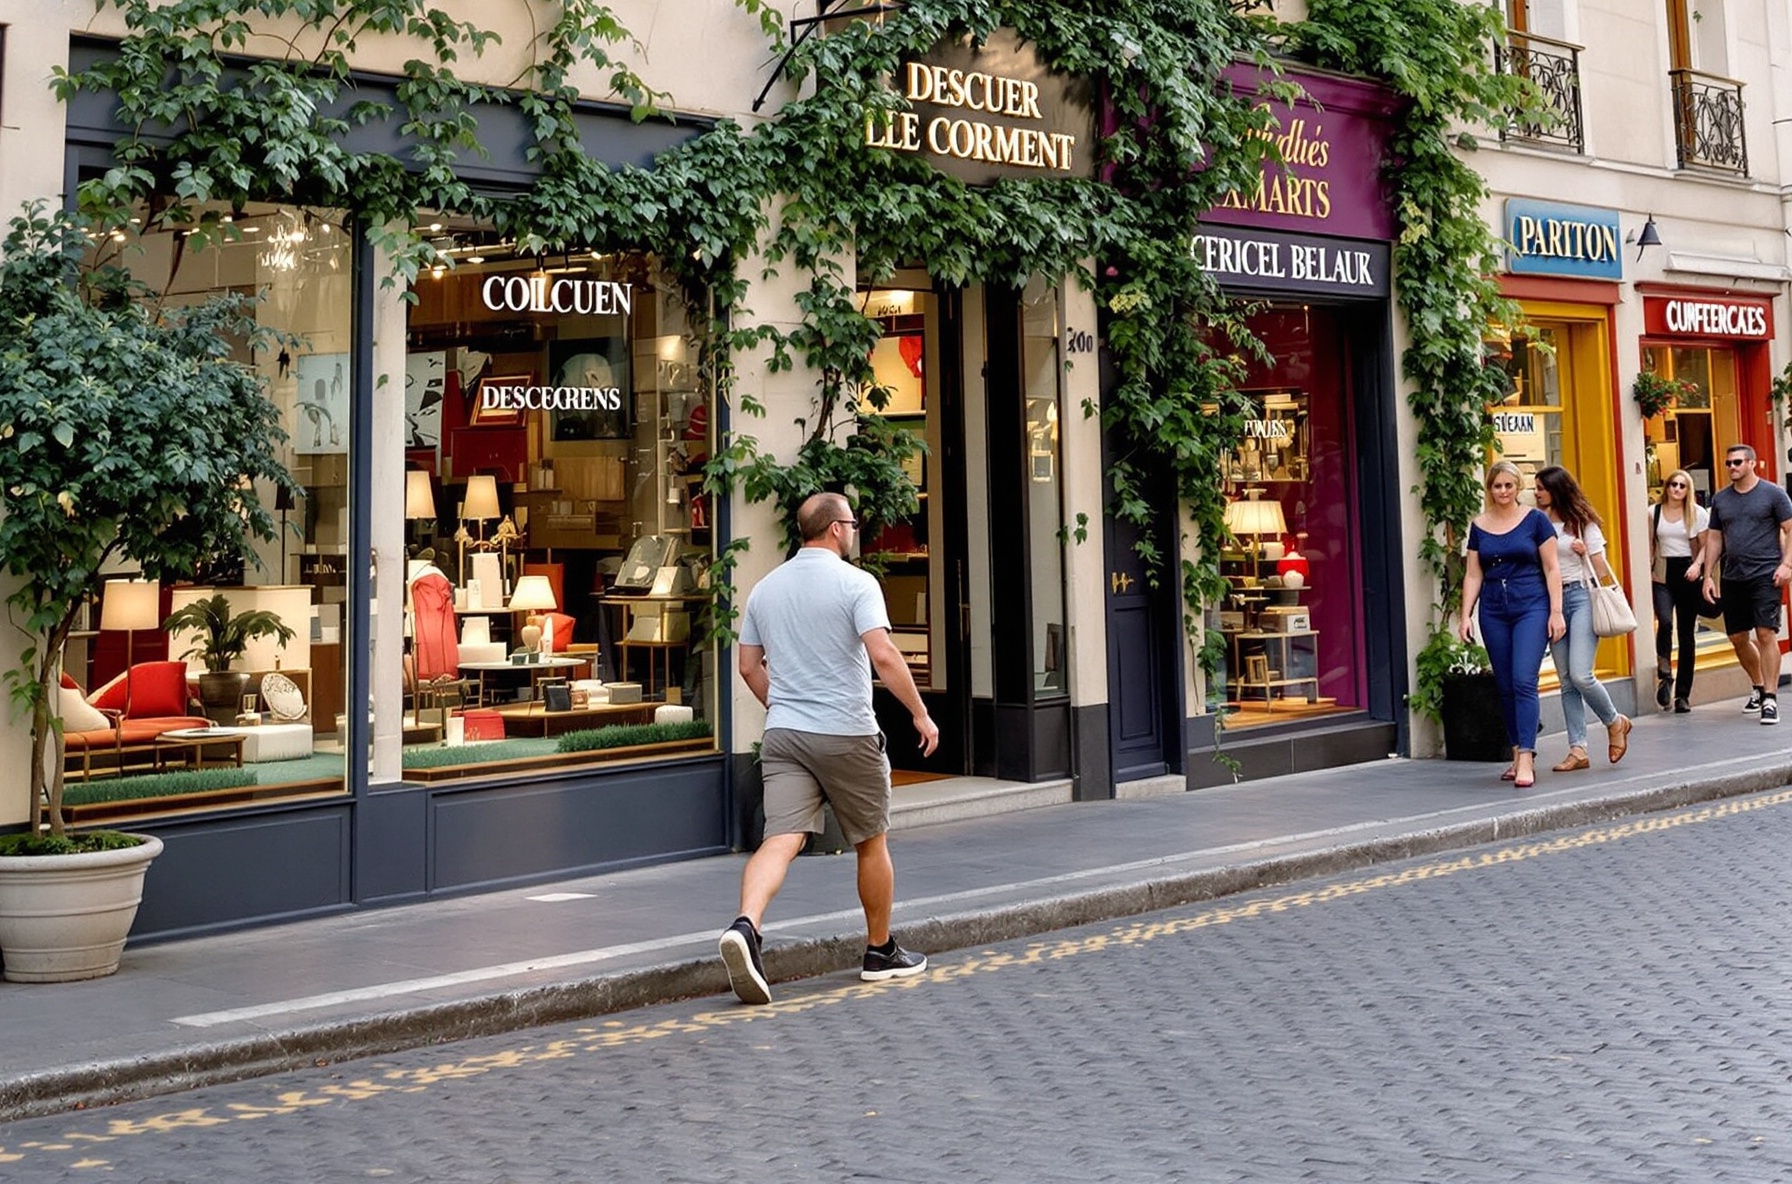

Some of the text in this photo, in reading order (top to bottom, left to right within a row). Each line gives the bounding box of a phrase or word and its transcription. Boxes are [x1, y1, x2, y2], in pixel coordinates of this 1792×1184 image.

[906, 61, 1043, 119] DESCUER
[926, 116, 1075, 171] CORMENT
[1190, 234, 1286, 278] CERICEL
[1518, 215, 1619, 263] PARITON
